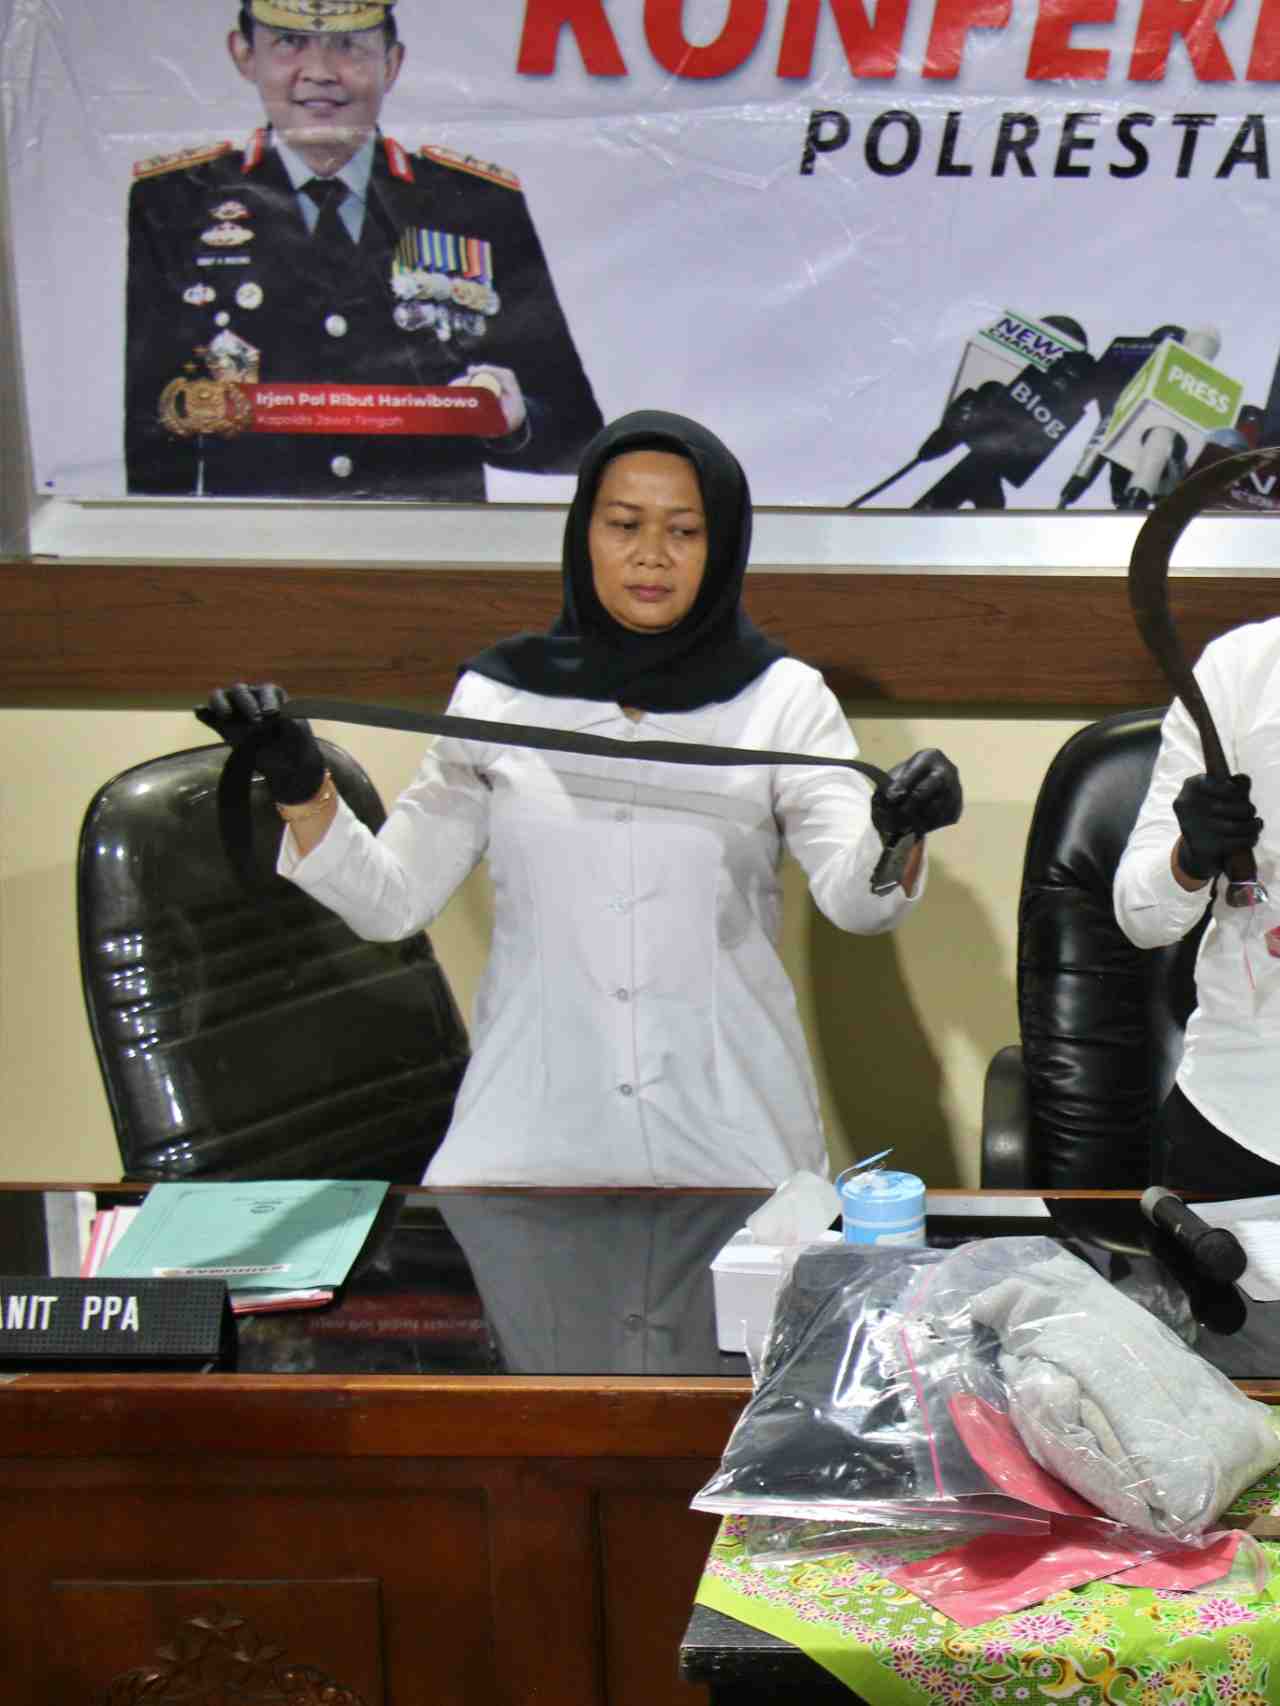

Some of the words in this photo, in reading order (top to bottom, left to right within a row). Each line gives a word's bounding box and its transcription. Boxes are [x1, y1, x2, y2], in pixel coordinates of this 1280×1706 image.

[800, 110, 1271, 179] POLRESTA
[256, 392, 294, 410] Irjen
[299, 393, 325, 406] Pol
[330, 393, 374, 407] Ribut
[379, 394, 478, 409] Hariwibowo
[1010, 382, 1067, 439] Blog
[1167, 365, 1231, 414] PRESS
[0, 1295, 59, 1331] NIT
[80, 1295, 139, 1332] PPA
